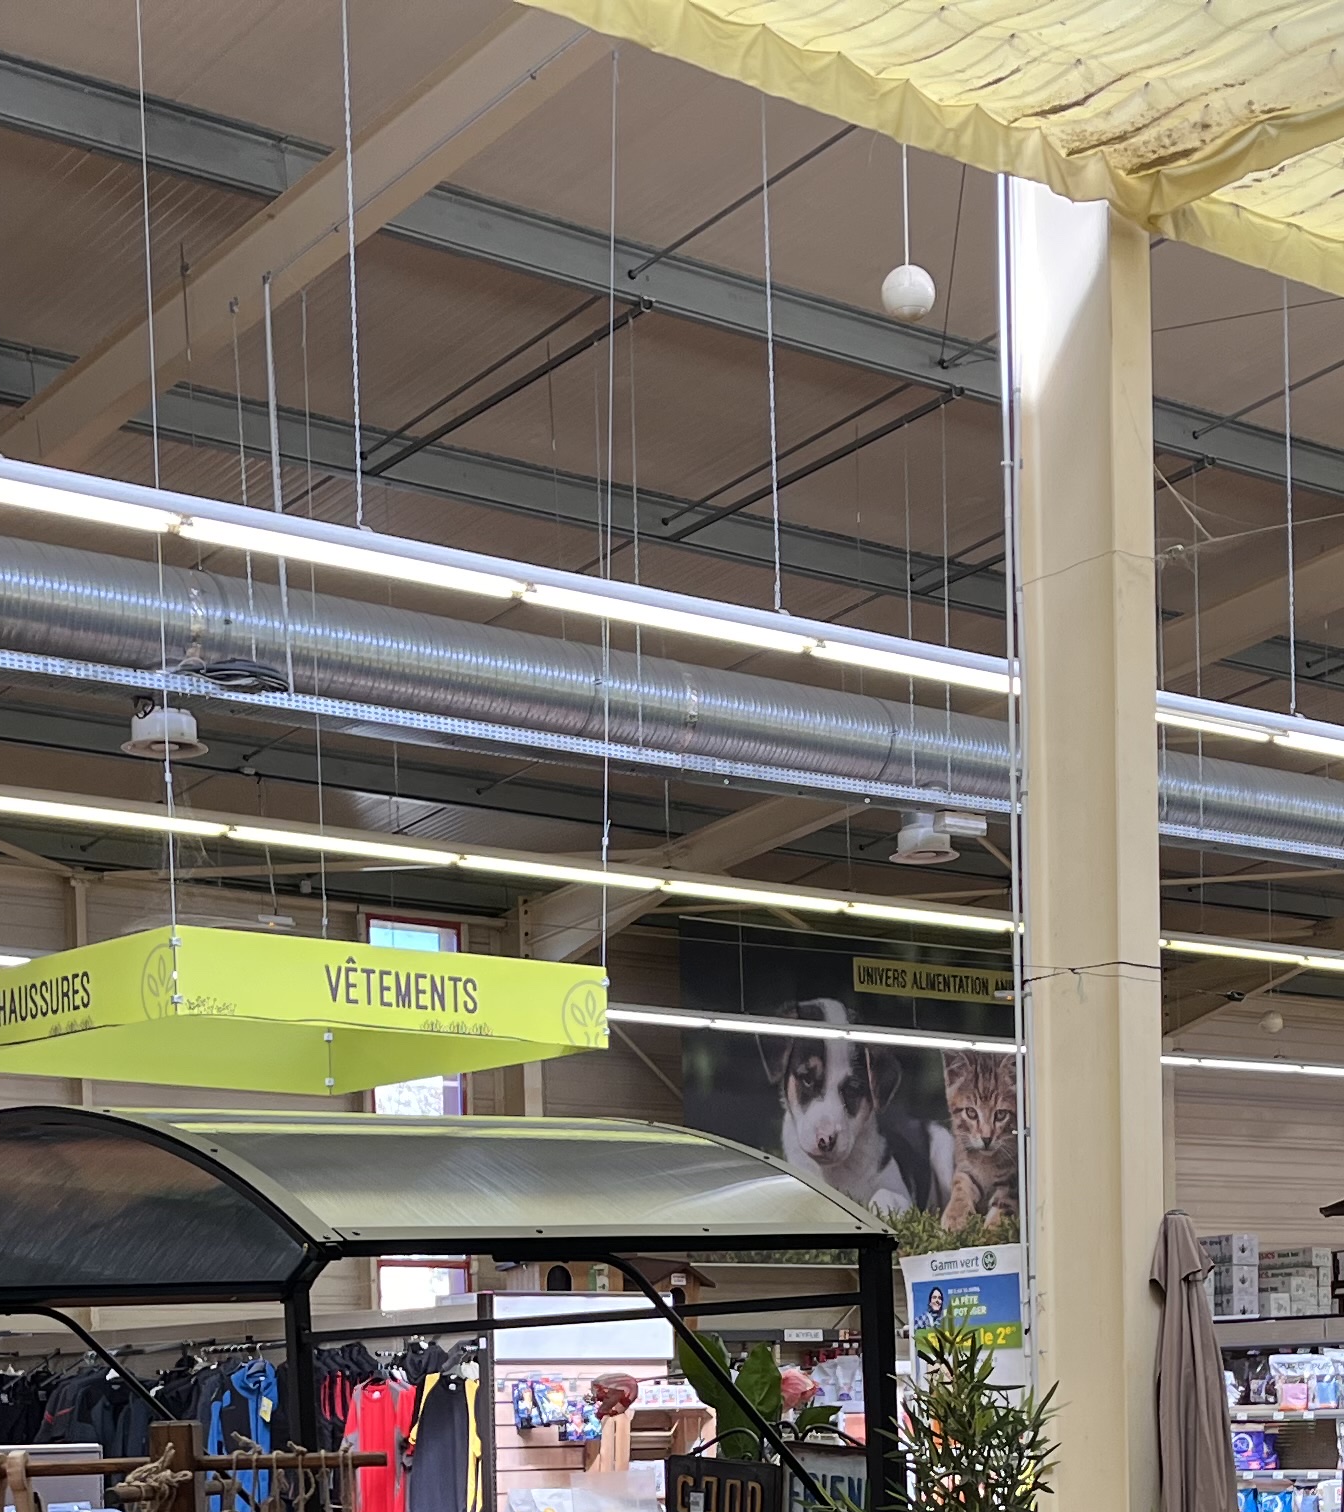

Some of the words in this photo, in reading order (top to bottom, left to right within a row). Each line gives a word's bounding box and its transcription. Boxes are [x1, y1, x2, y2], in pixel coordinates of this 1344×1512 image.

[324, 956, 479, 1014] VÊTEMENTS
[857, 965, 907, 989] UNIVERS
[911, 970, 990, 996] ALIMENTATION
[930, 1258, 958, 1272] Gamm
[959, 1255, 980, 1268] vert
[979, 1327, 994, 1346] le
